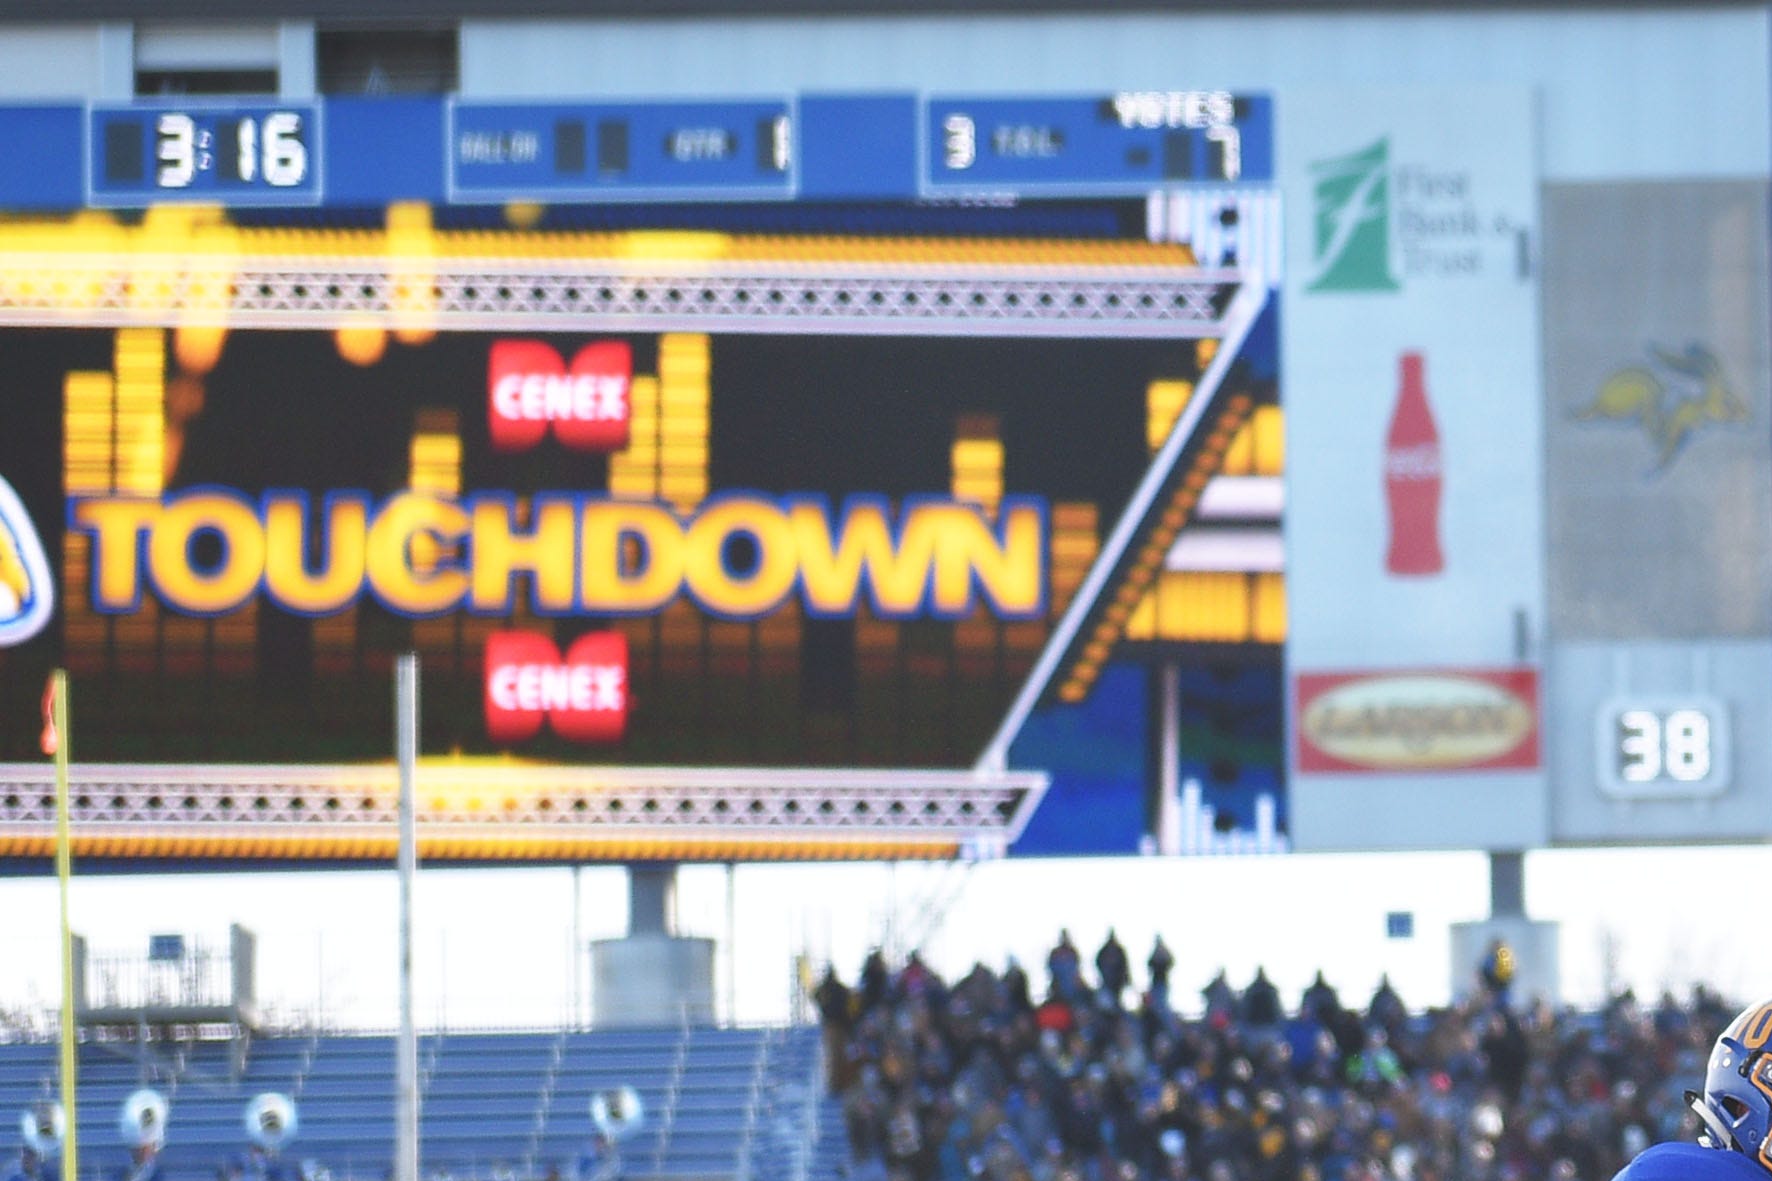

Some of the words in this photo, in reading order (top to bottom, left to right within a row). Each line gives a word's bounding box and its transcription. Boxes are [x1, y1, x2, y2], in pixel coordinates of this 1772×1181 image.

[1205, 125, 1240, 182] 7
[492, 373, 629, 421] CENEX
[67, 486, 1044, 619] TOUCHDOWN
[490, 664, 626, 711] CENEX
[1621, 709, 1710, 782] 38
